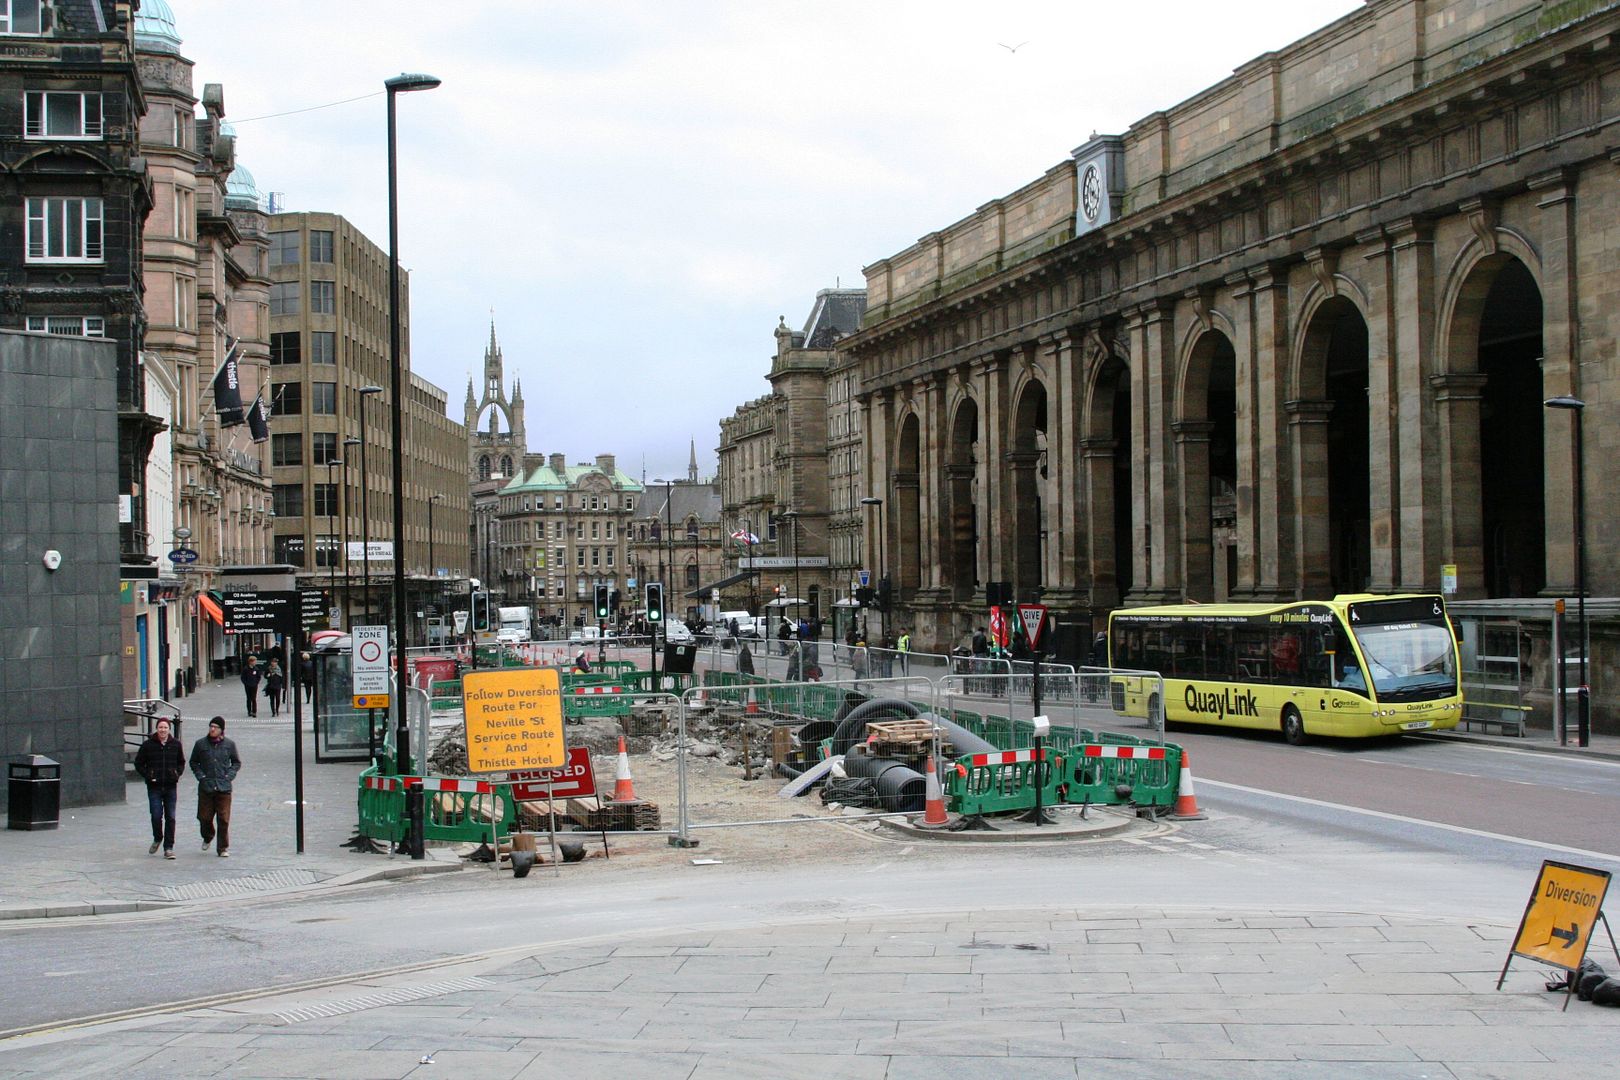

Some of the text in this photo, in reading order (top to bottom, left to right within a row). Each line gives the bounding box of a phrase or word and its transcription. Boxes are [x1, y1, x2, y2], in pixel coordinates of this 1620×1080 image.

[227, 361, 238, 390] thistle
[225, 582, 258, 592] thistle
[1023, 611, 1040, 620] GIVE
[1270, 613, 1333, 624] every 10 minutes QuayLink
[466, 686, 559, 701] Follow Diversion
[482, 700, 538, 713] Route For
[1184, 684, 1259, 720] QuayLink
[1406, 703, 1433, 711] QuayLink
[486, 716, 545, 729] Neville St
[474, 729, 554, 744] Service Route
[505, 743, 528, 753] And
[478, 755, 553, 769] Thistle Hotel
[517, 765, 586, 780] CLOSED
[1545, 879, 1598, 908] Diversion
